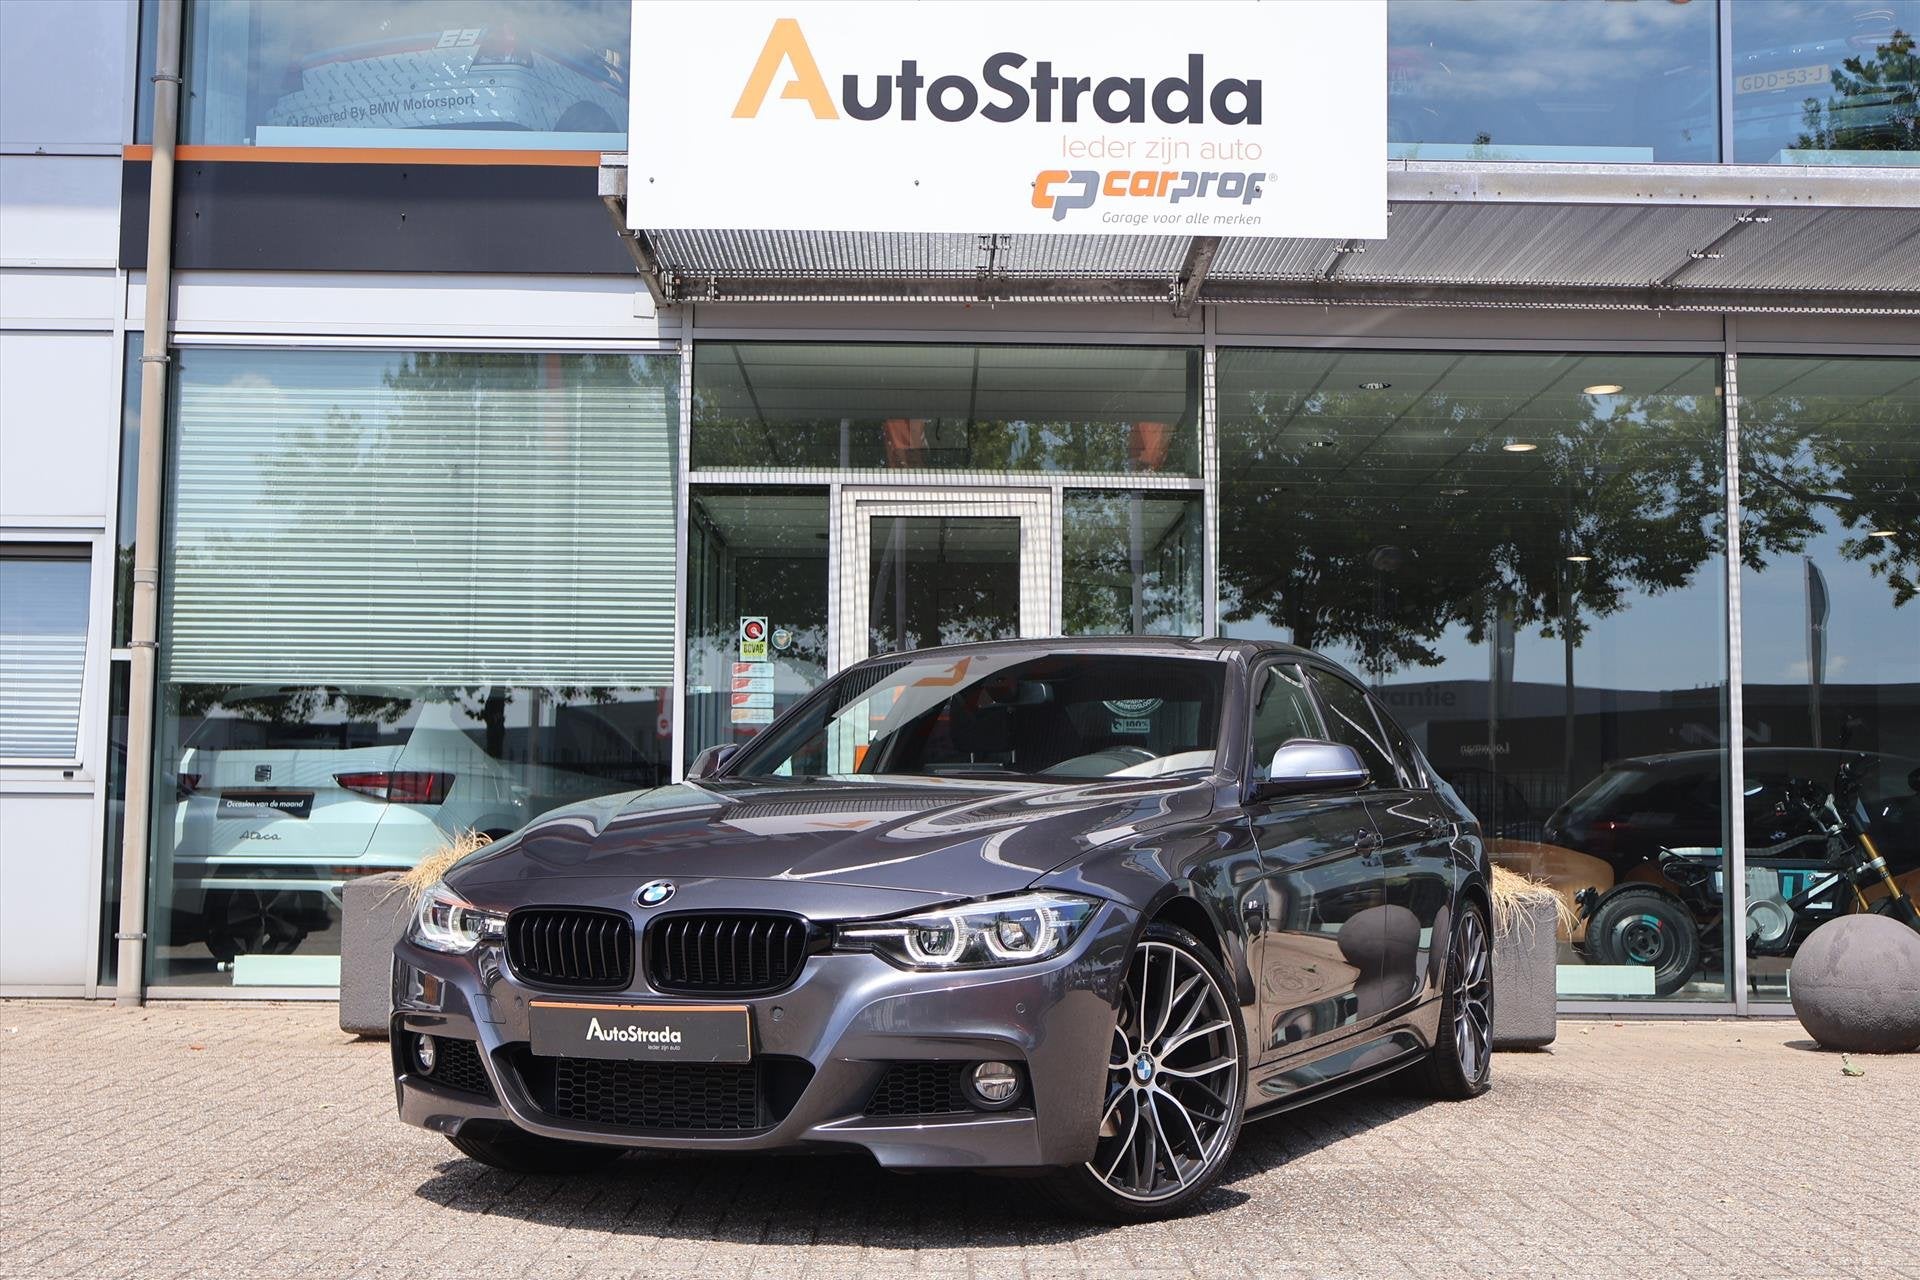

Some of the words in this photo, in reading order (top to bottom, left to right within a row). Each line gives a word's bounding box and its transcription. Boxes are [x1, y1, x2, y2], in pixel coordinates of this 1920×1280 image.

[731, 18, 1263, 125] AutoStrada
[1742, 67, 1823, 91] GDD-53-J
[302, 108, 347, 127] Powered
[351, 106, 366, 120] By
[370, 101, 400, 115] BMW
[403, 93, 476, 111] Motorsport
[1062, 135, 1137, 159] Ieder
[1145, 137, 1190, 165] zijn
[1200, 138, 1263, 161] auto
[1102, 212, 1149, 226] Garage
[1153, 213, 1182, 224] voor
[1185, 210, 1209, 225] alle
[1213, 213, 1262, 225] merken
[743, 643, 764, 654] BOVAG
[226, 800, 255, 808] Occasion
[270, 800, 278, 808] de
[279, 800, 304, 808] maand
[239, 830, 282, 840] Ateca
[586, 1017, 682, 1043] AutoStrada
